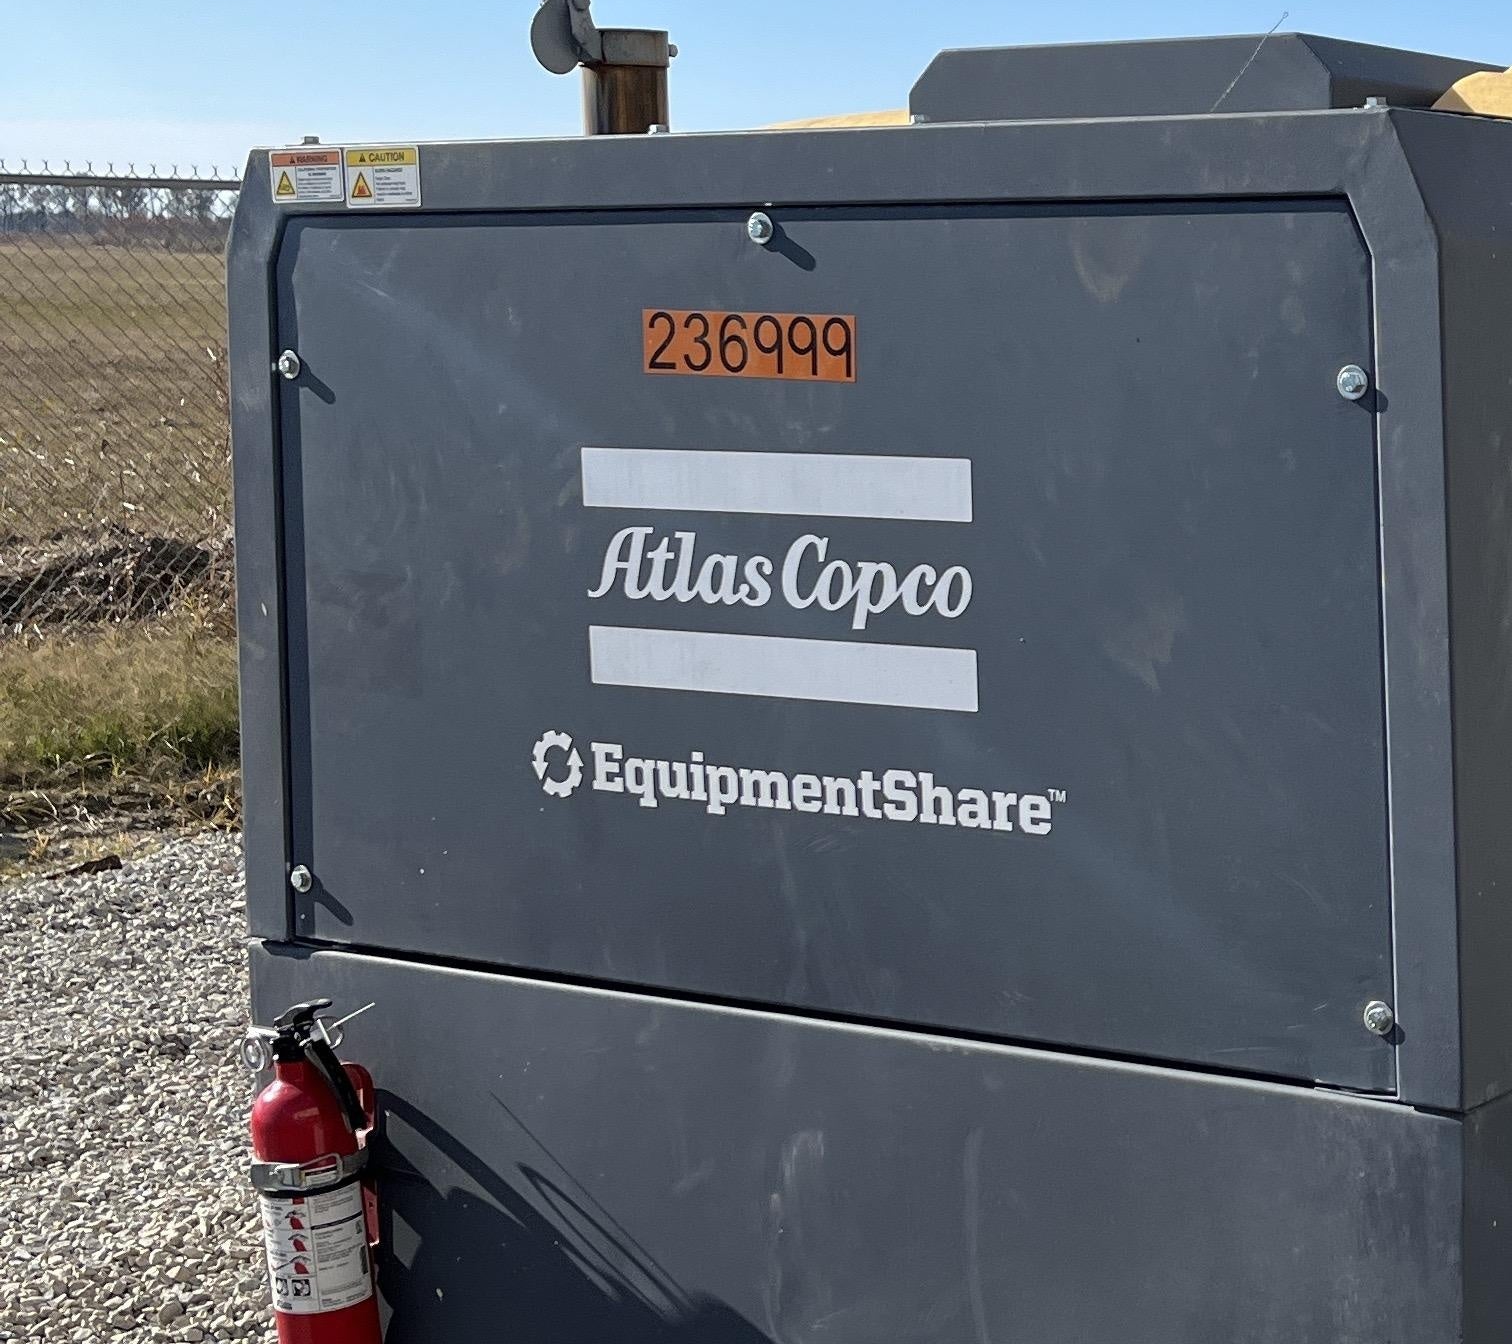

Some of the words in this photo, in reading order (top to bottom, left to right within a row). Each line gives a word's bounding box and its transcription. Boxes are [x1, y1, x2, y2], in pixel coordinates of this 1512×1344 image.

[368, 152, 405, 163] CAUTION
[648, 311, 853, 378] 236999
[587, 525, 775, 608] Atlas
[781, 533, 974, 631] Copco
